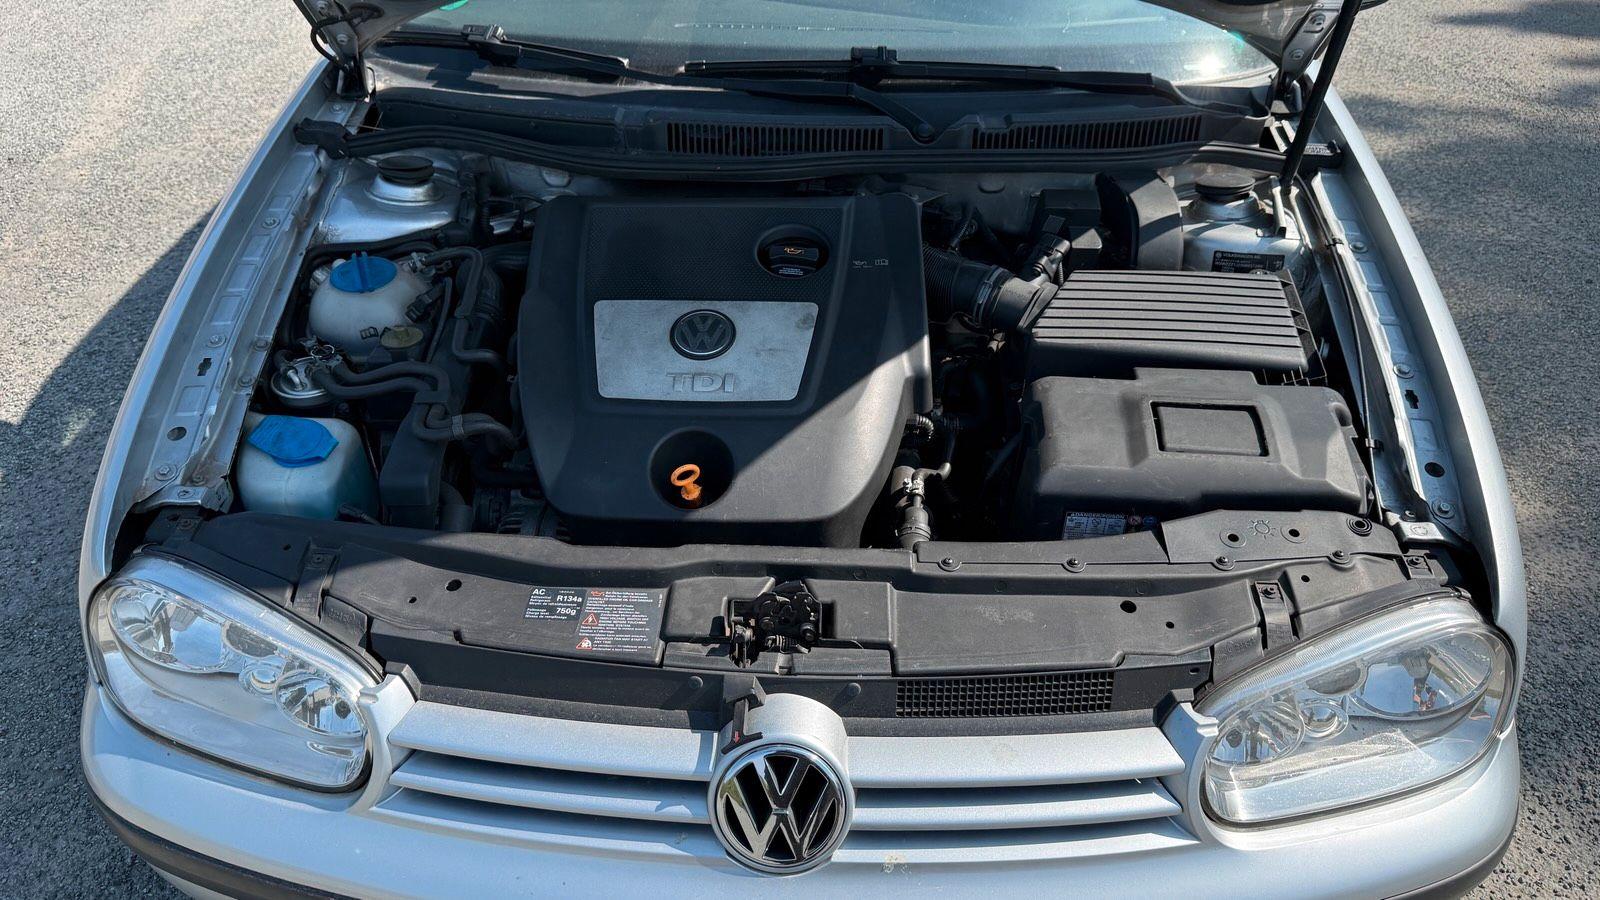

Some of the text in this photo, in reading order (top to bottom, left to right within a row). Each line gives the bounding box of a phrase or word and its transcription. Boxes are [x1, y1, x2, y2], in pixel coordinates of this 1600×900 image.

[666, 372, 735, 393] TDI
[556, 608, 576, 616] 750g
[717, 746, 843, 865] VW
